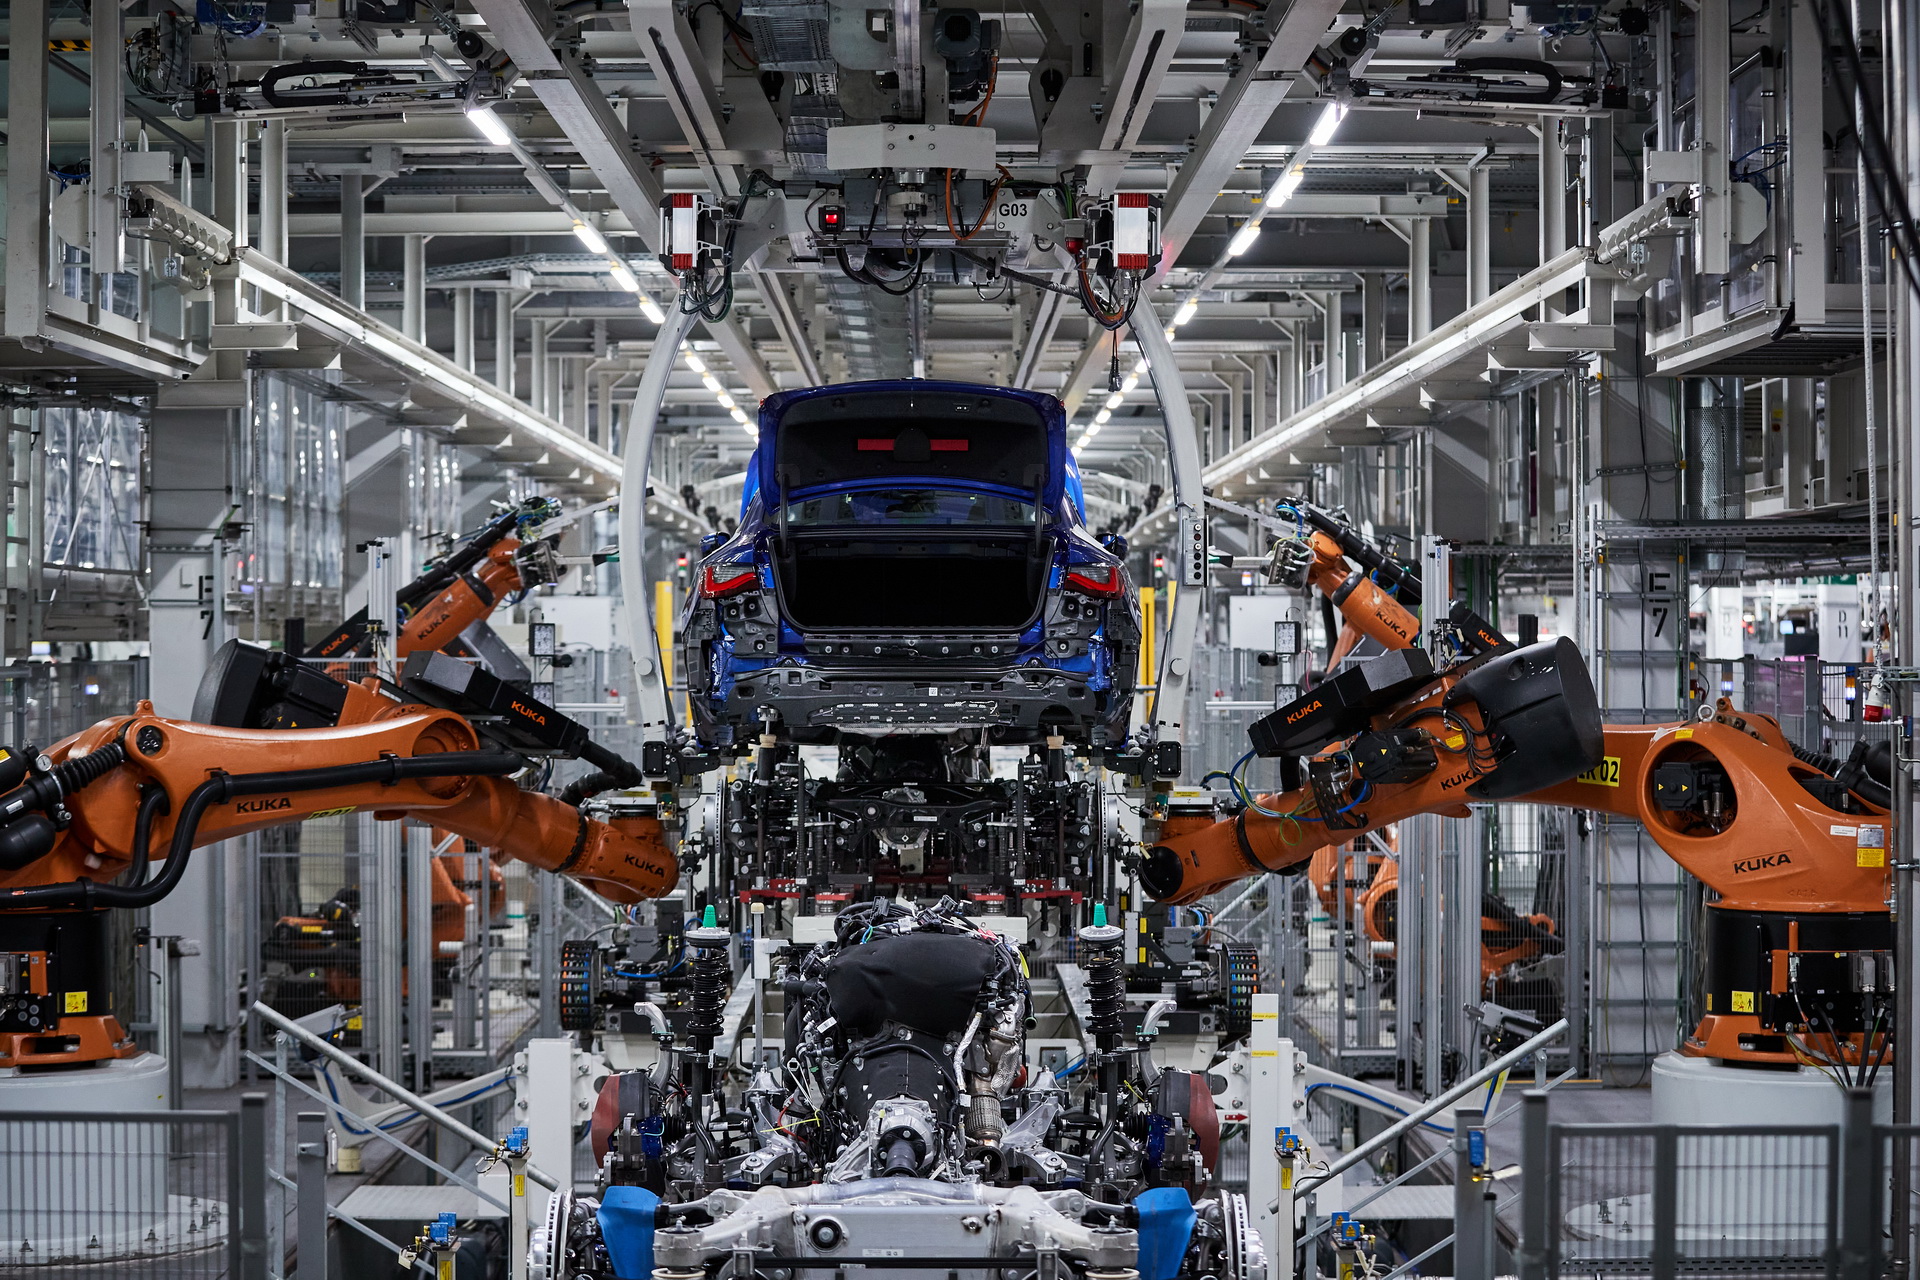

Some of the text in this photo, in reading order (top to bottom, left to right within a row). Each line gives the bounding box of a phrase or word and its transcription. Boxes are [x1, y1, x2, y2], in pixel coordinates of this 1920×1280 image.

[999, 203, 1028, 217] G03
[1649, 573, 1670, 603] E
[200, 610, 213, 640] 7
[417, 614, 450, 640] KUKA
[1375, 611, 1407, 640] KUKA
[1653, 607, 1668, 637] 7
[1838, 609, 1847, 623] D
[1477, 629, 1499, 647] KUK
[1838, 625, 1848, 638] 11
[320, 634, 349, 656] KUKA
[511, 700, 545, 726] KUKA
[1286, 700, 1322, 724] KUKA
[1600, 760, 1619, 782] 02
[236, 797, 292, 814] KUKA
[624, 854, 665, 878] KUKA
[1734, 853, 1791, 874] KUKA
